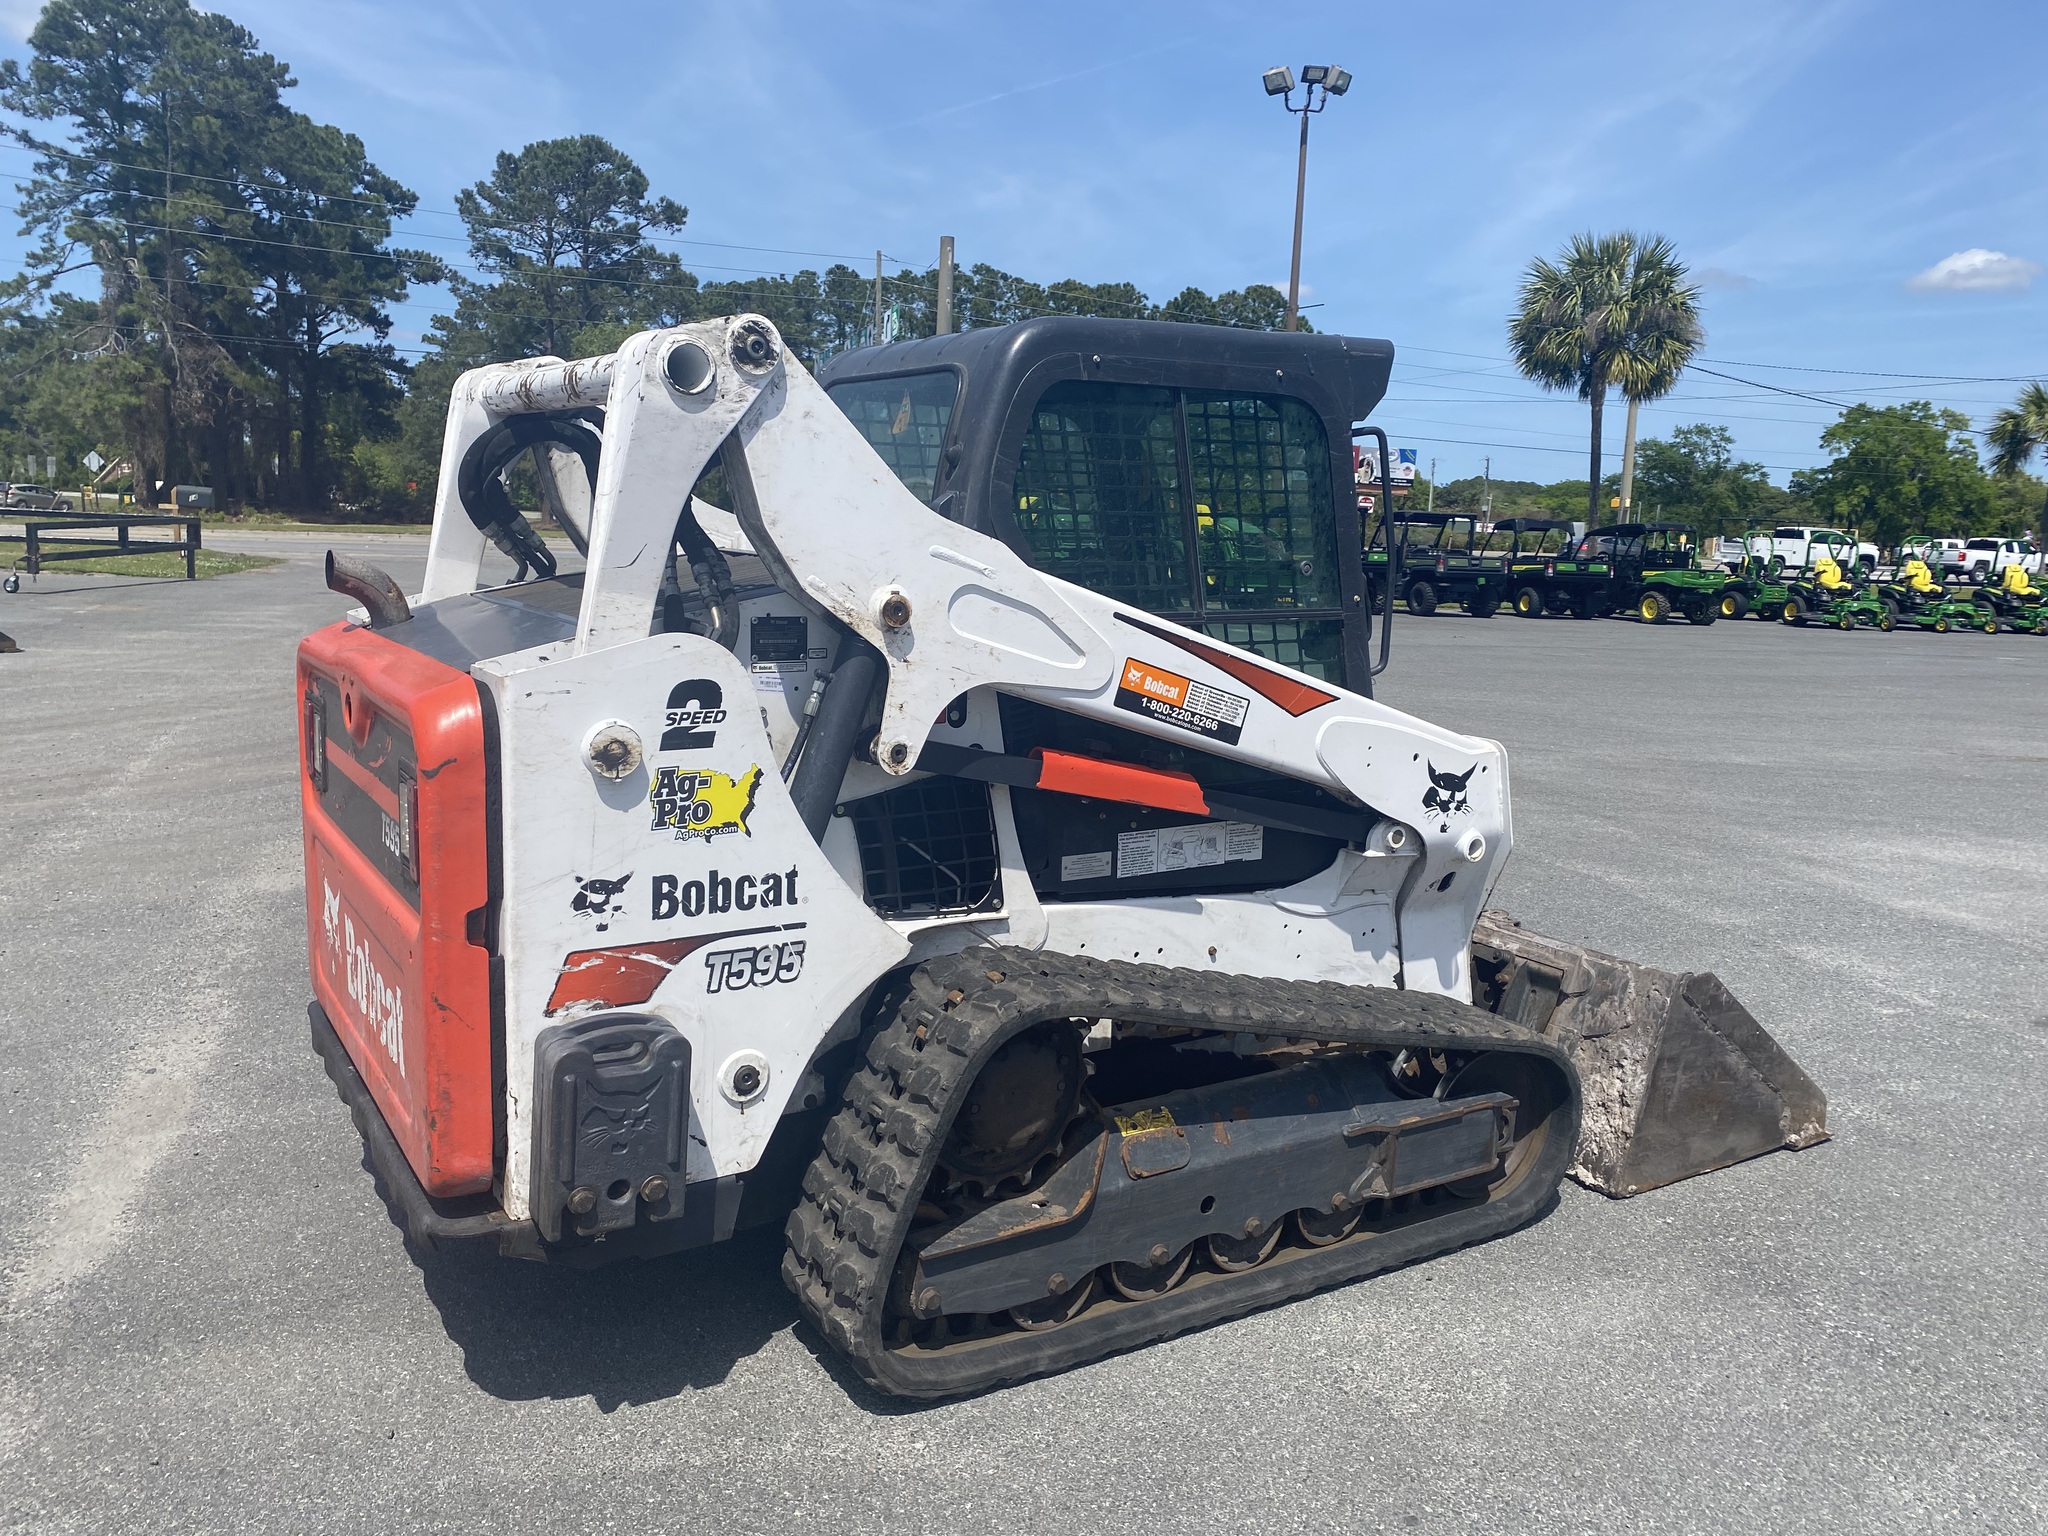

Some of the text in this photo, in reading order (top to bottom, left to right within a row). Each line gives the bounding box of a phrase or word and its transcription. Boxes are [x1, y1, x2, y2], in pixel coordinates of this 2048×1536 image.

[1143, 676, 1180, 700] Bobcat
[659, 678, 723, 751] 2
[664, 709, 727, 726] SPEED
[1141, 697, 1219, 731] 1-800-220-6266
[651, 767, 712, 802] Ag-
[651, 798, 712, 830] Pro
[675, 825, 739, 841] AgProCo.com
[652, 864, 799, 921] Bobcat
[705, 940, 808, 995] T595
